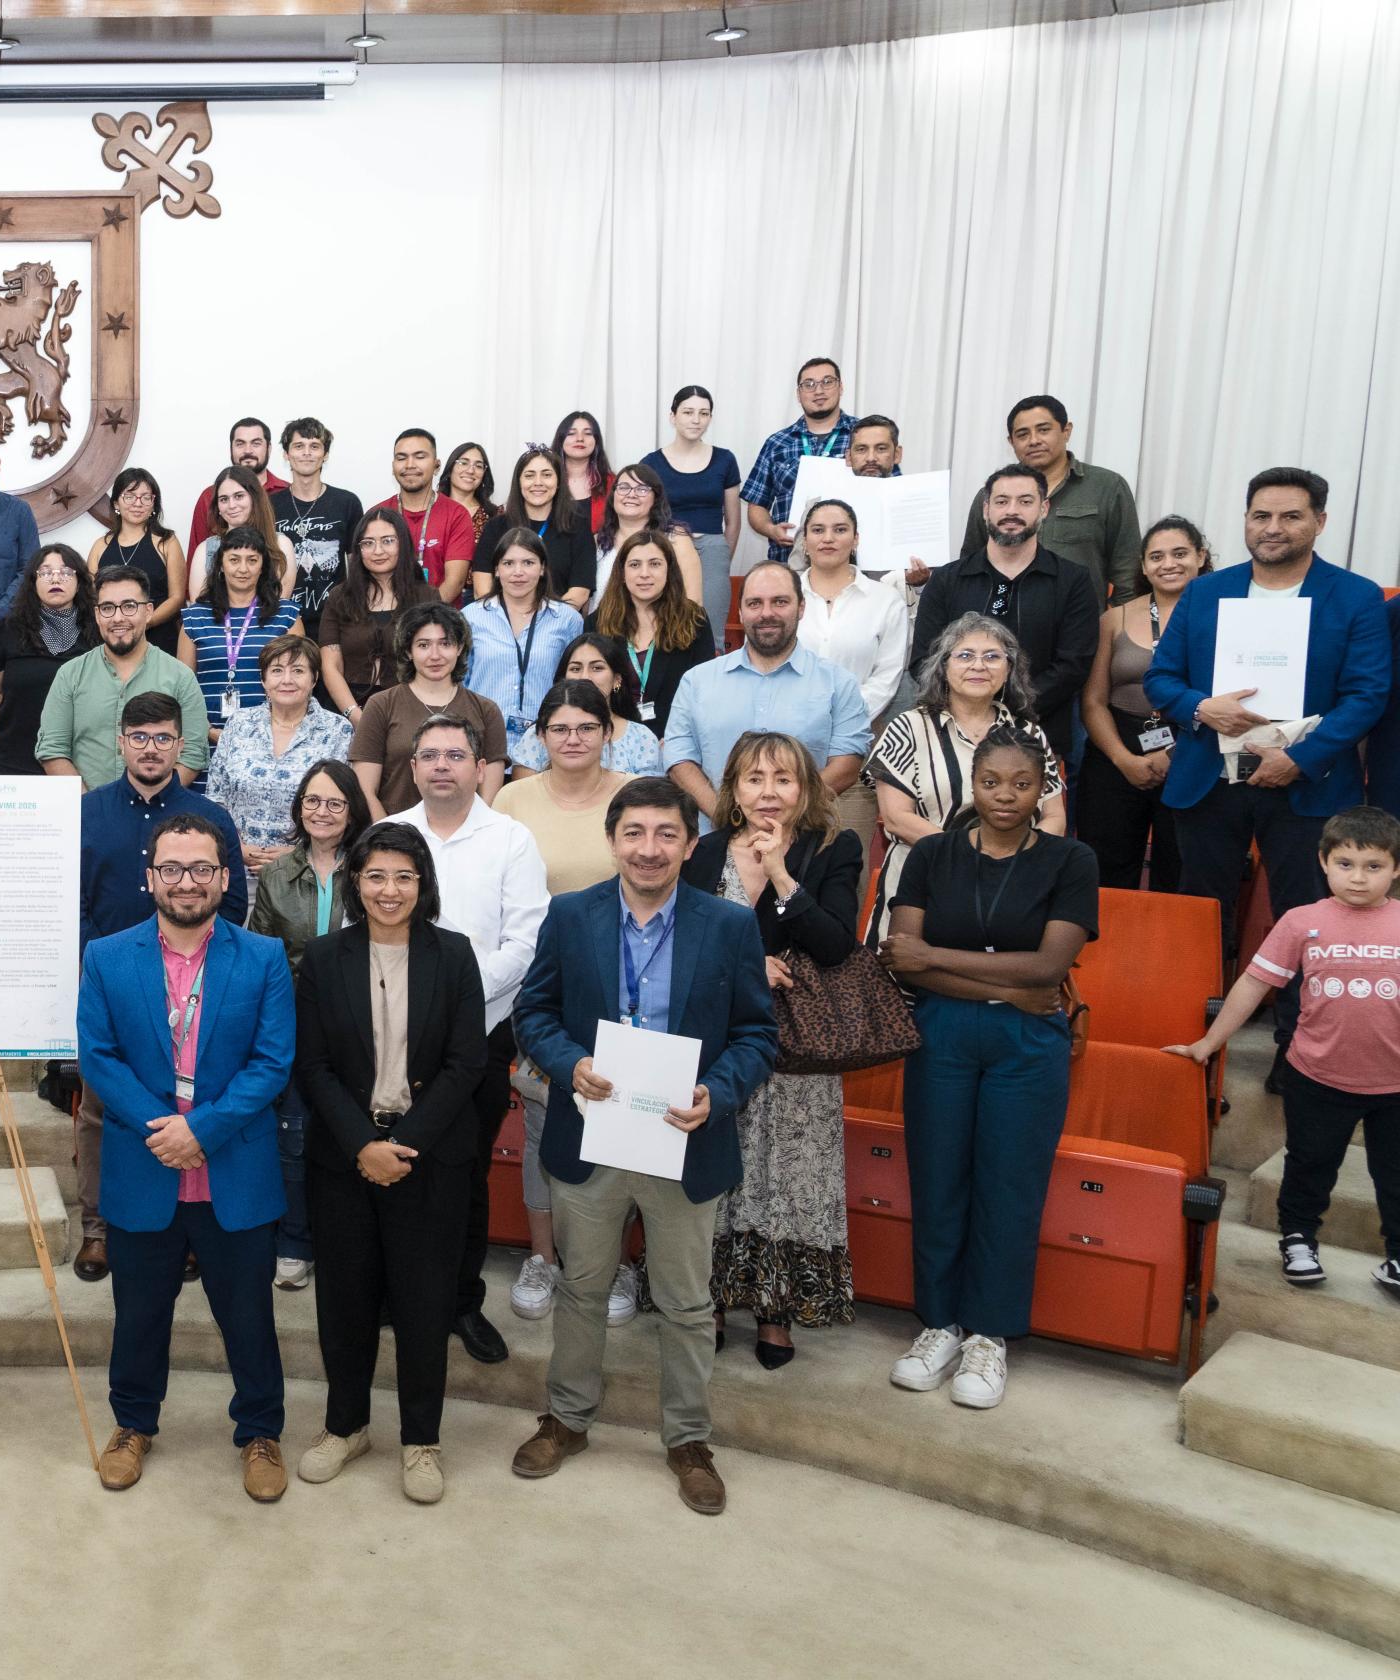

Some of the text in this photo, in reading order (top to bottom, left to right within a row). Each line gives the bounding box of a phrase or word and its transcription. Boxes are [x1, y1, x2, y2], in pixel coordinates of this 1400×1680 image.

[304, 581, 334, 611] WA
[0, 801, 17, 809] VIME
[1082, 1182, 1090, 1190] A
